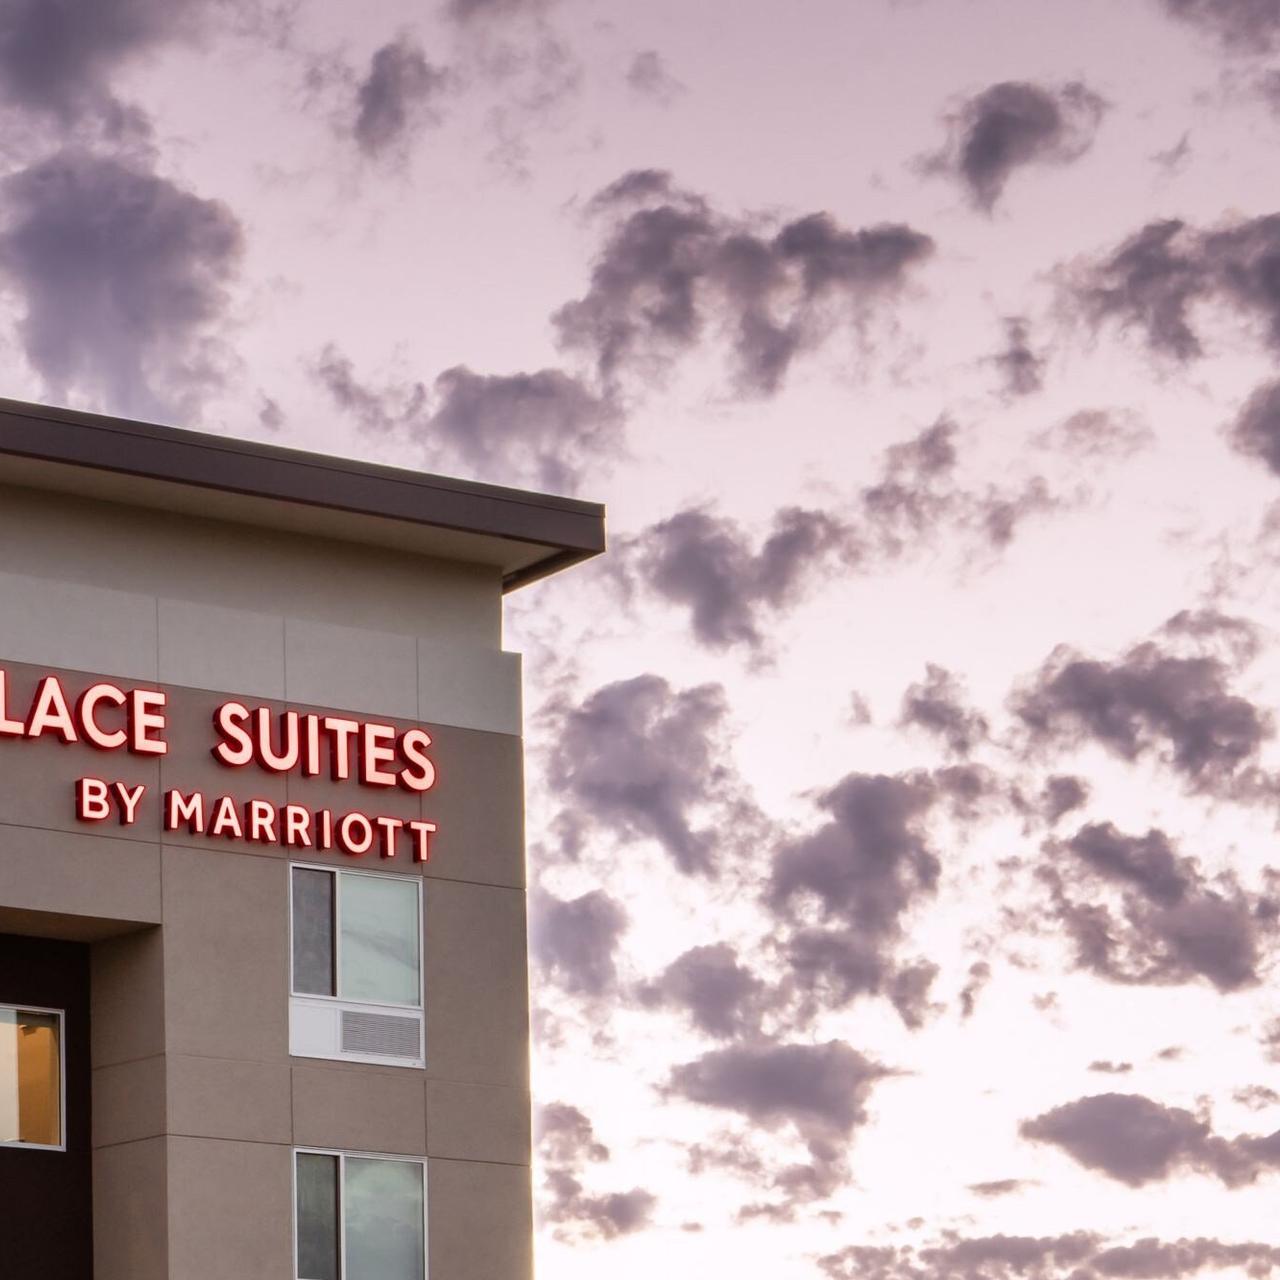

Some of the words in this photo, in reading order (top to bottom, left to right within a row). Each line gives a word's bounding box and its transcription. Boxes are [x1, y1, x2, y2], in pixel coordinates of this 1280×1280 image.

[213, 701, 437, 792] SUITES
[75, 776, 145, 825] BY
[164, 790, 437, 862] MARRIOTT
